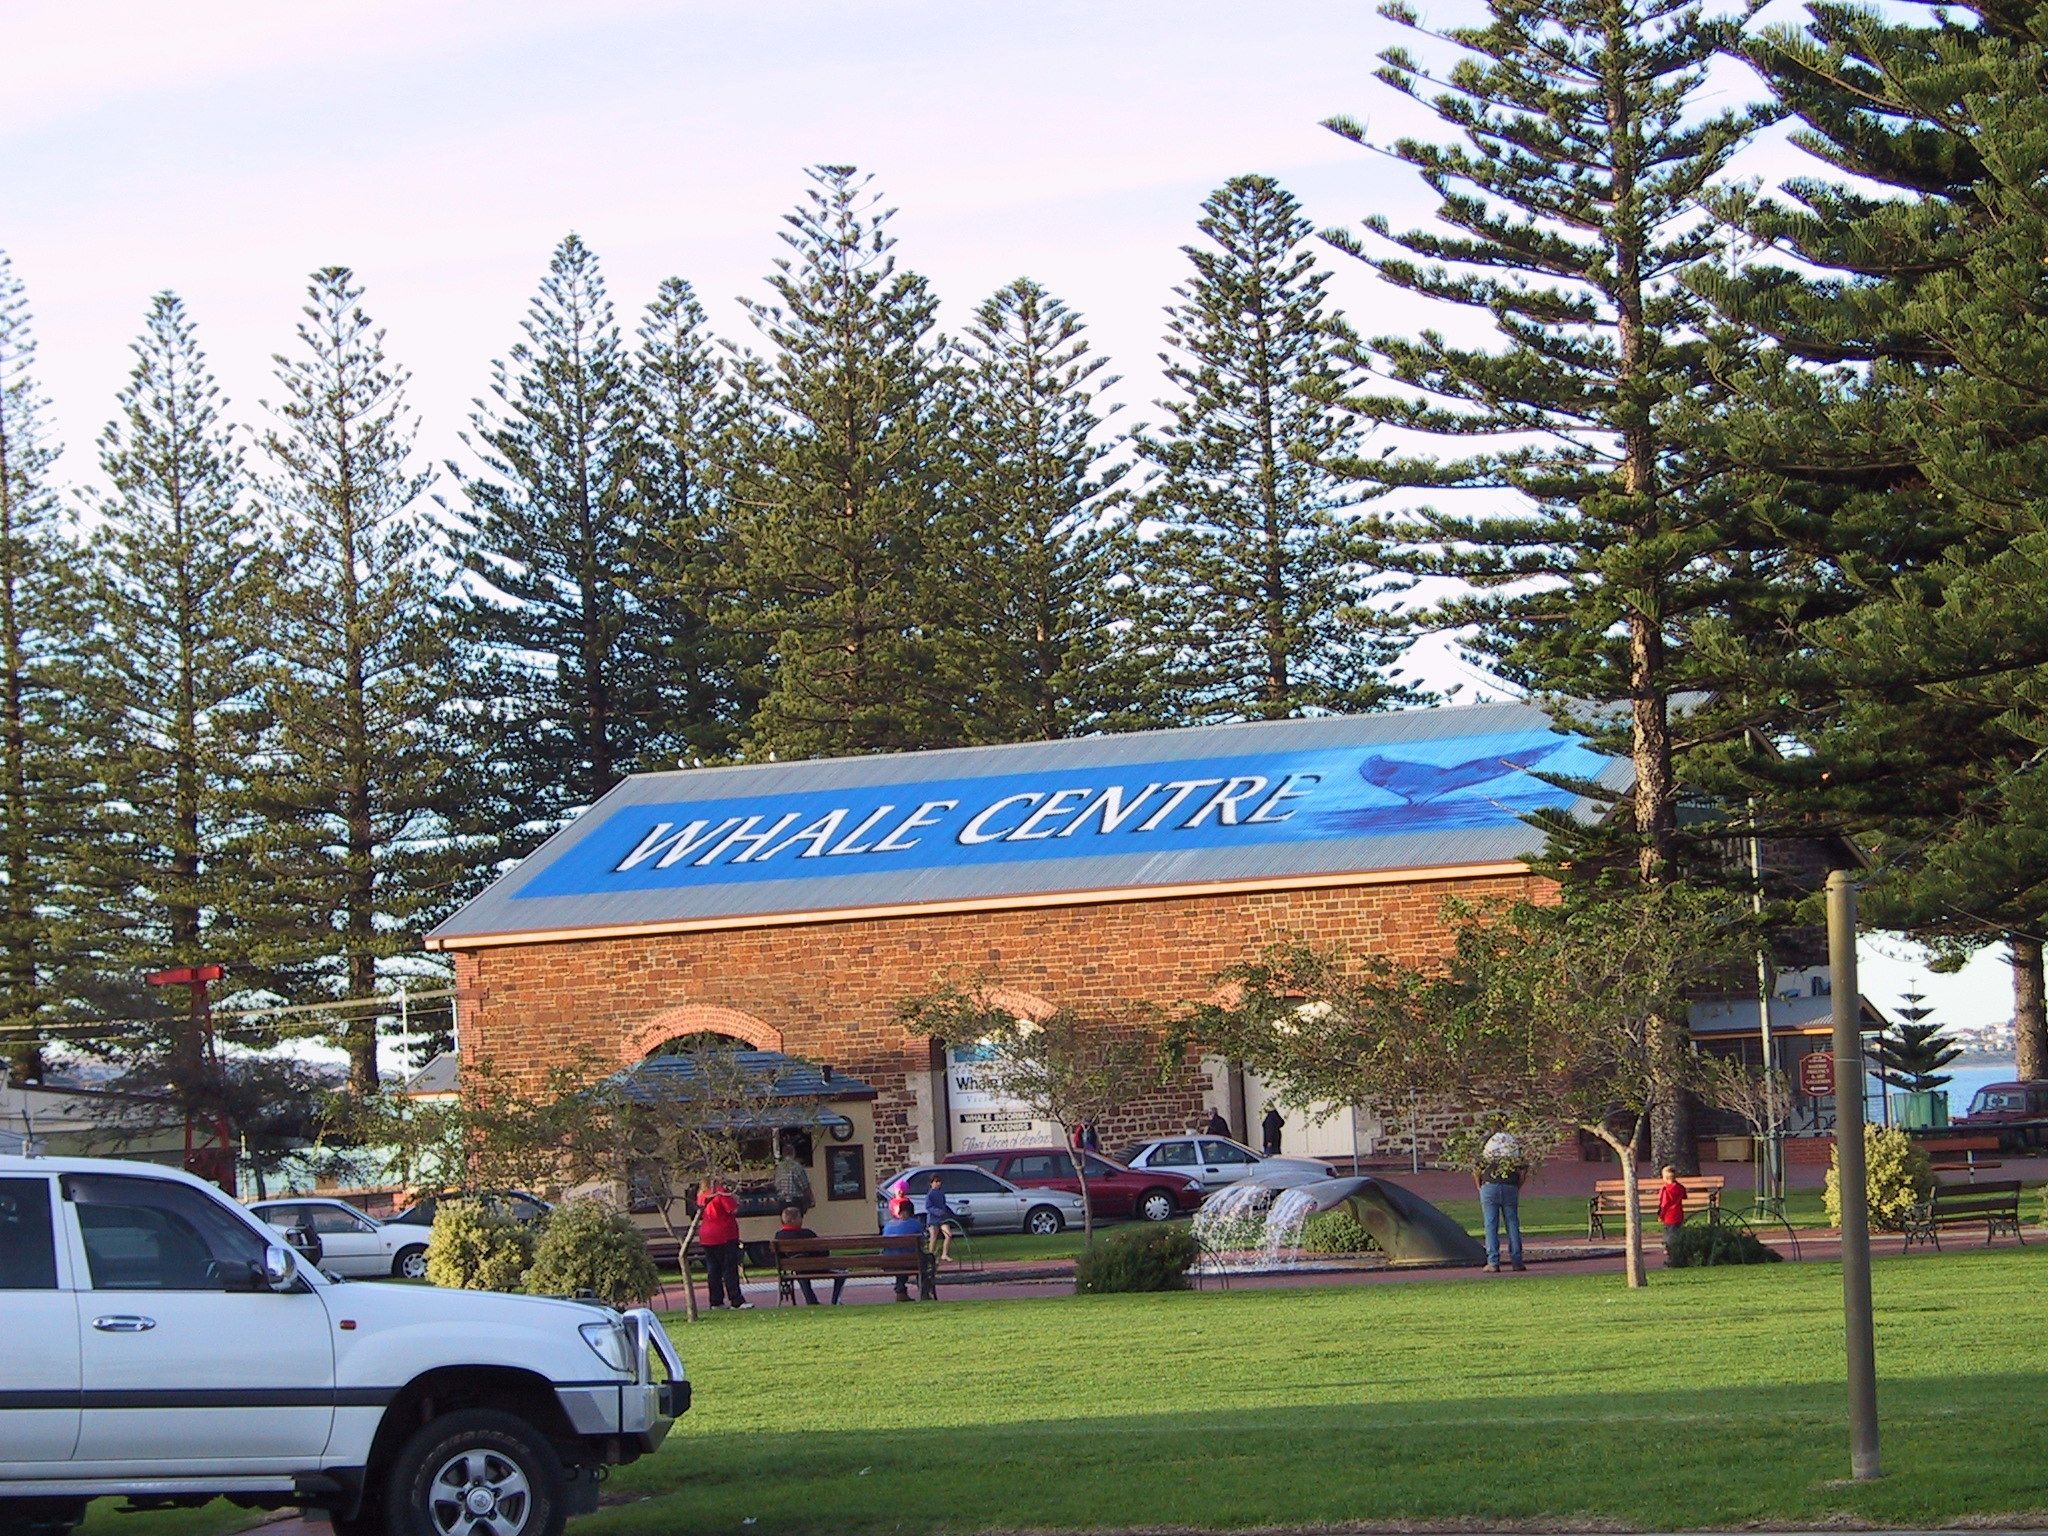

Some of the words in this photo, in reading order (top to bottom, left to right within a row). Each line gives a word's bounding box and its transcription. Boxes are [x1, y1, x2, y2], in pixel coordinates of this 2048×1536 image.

[615, 799, 960, 873] WHALE
[957, 773, 1323, 846] CENTRE
[984, 1123, 1028, 1132] SOUVENIRS
